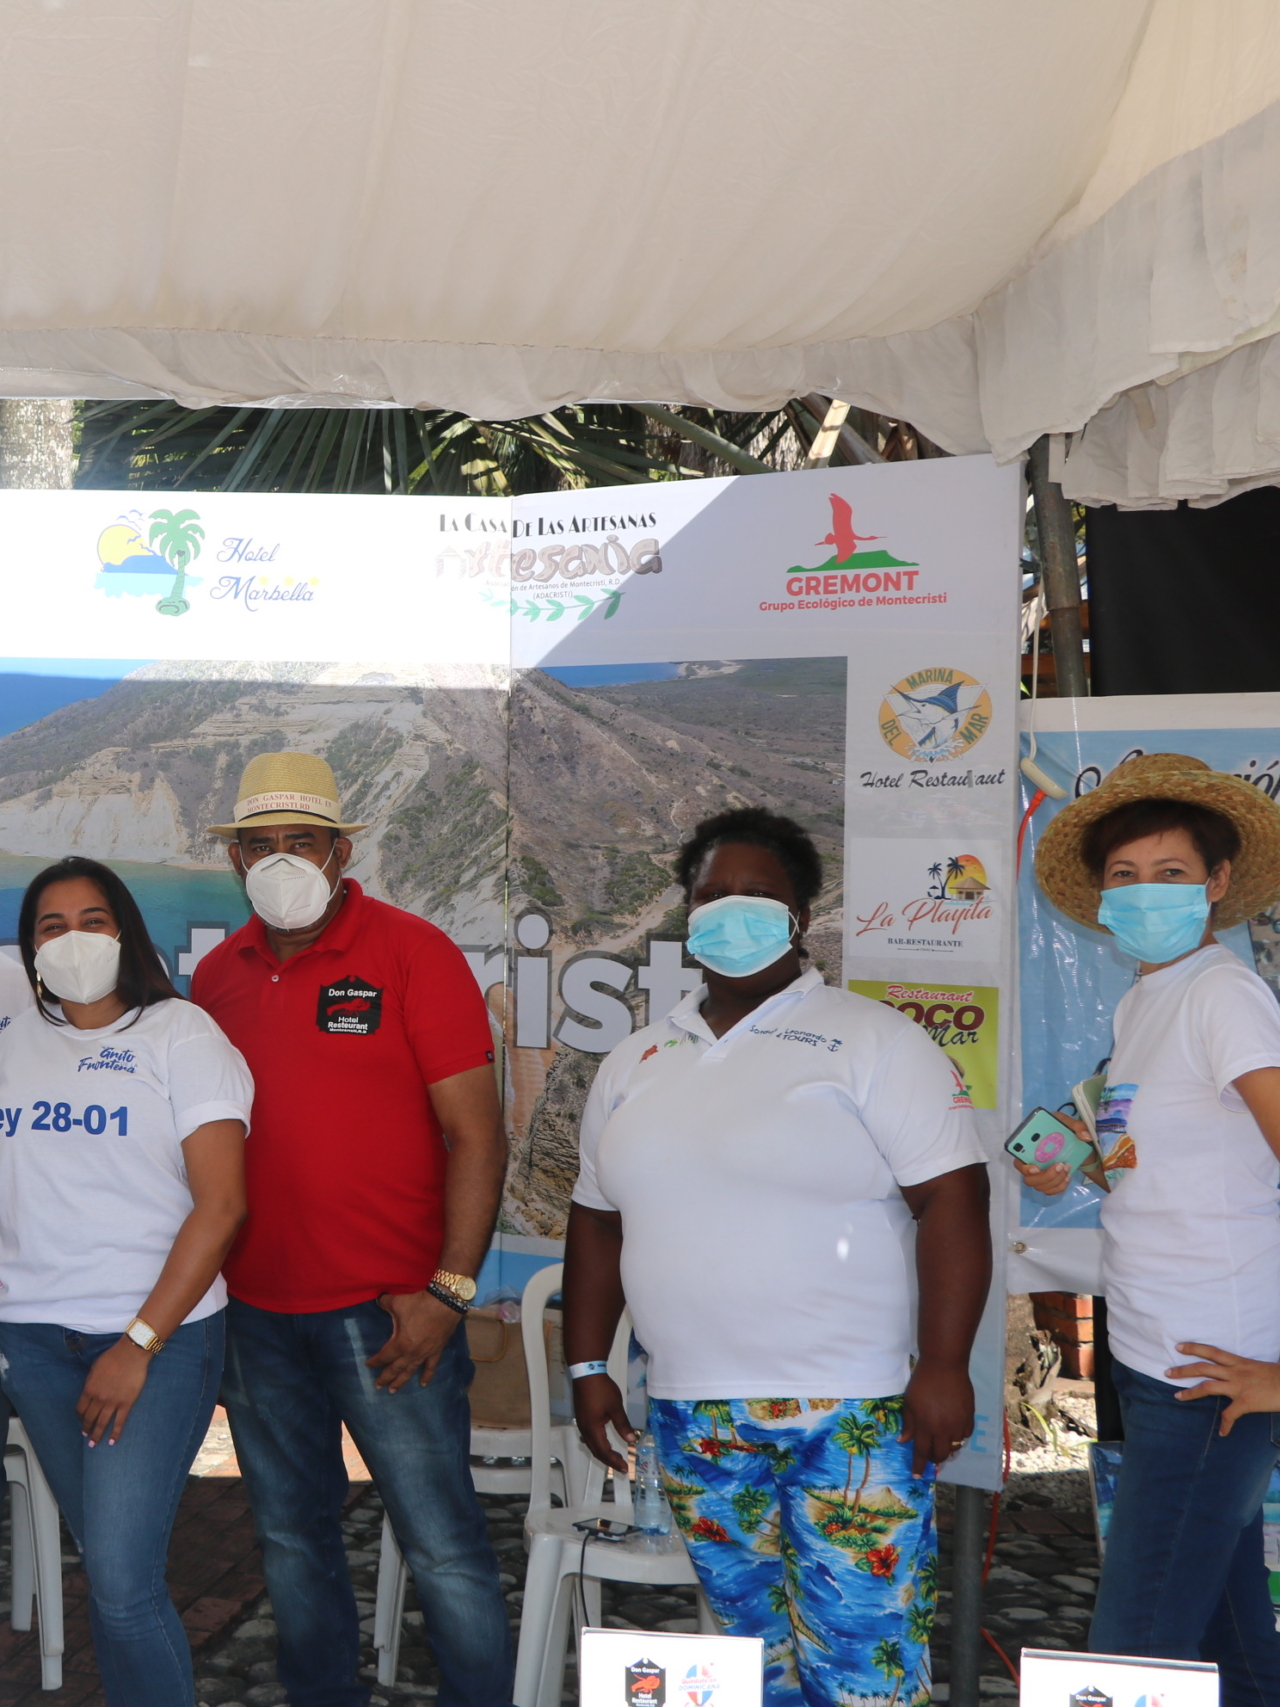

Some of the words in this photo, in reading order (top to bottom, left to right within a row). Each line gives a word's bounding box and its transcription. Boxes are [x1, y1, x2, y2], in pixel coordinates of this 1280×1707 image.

[216, 537, 280, 563] Hotel
[528, 582, 559, 591] Artesanos
[560, 580, 569, 589] de
[786, 570, 919, 597] GREMONT
[210, 576, 314, 612] Marbella
[532, 591, 573, 600] (ADACRISTI)
[759, 602, 795, 612] Grupo
[798, 598, 856, 611] Ecológico
[858, 596, 873, 607] de
[876, 592, 948, 606] Montecristi
[905, 668, 954, 690] MARINA
[880, 718, 902, 746] DEL
[959, 713, 989, 745] MAR
[860, 771, 904, 788] Hotel
[246, 796, 258, 806] DON
[300, 795, 322, 805] HOTEL
[247, 802, 298, 813] MONTECRISTI
[856, 902, 896, 937] La
[902, 896, 993, 935] Playita
[887, 937, 964, 948] BAR-RESTAURANTE
[328, 988, 345, 996] Don
[347, 989, 377, 998] Gaspar
[886, 984, 973, 1002] Restaurant
[879, 1000, 984, 1031] OCO
[783, 1034, 818, 1047] TOURS
[785, 1028, 827, 1043] Leonardo
[100, 1047, 136, 1062] Grito
[78, 1057, 135, 1073] Frontera
[31, 1100, 128, 1137] 28-01
